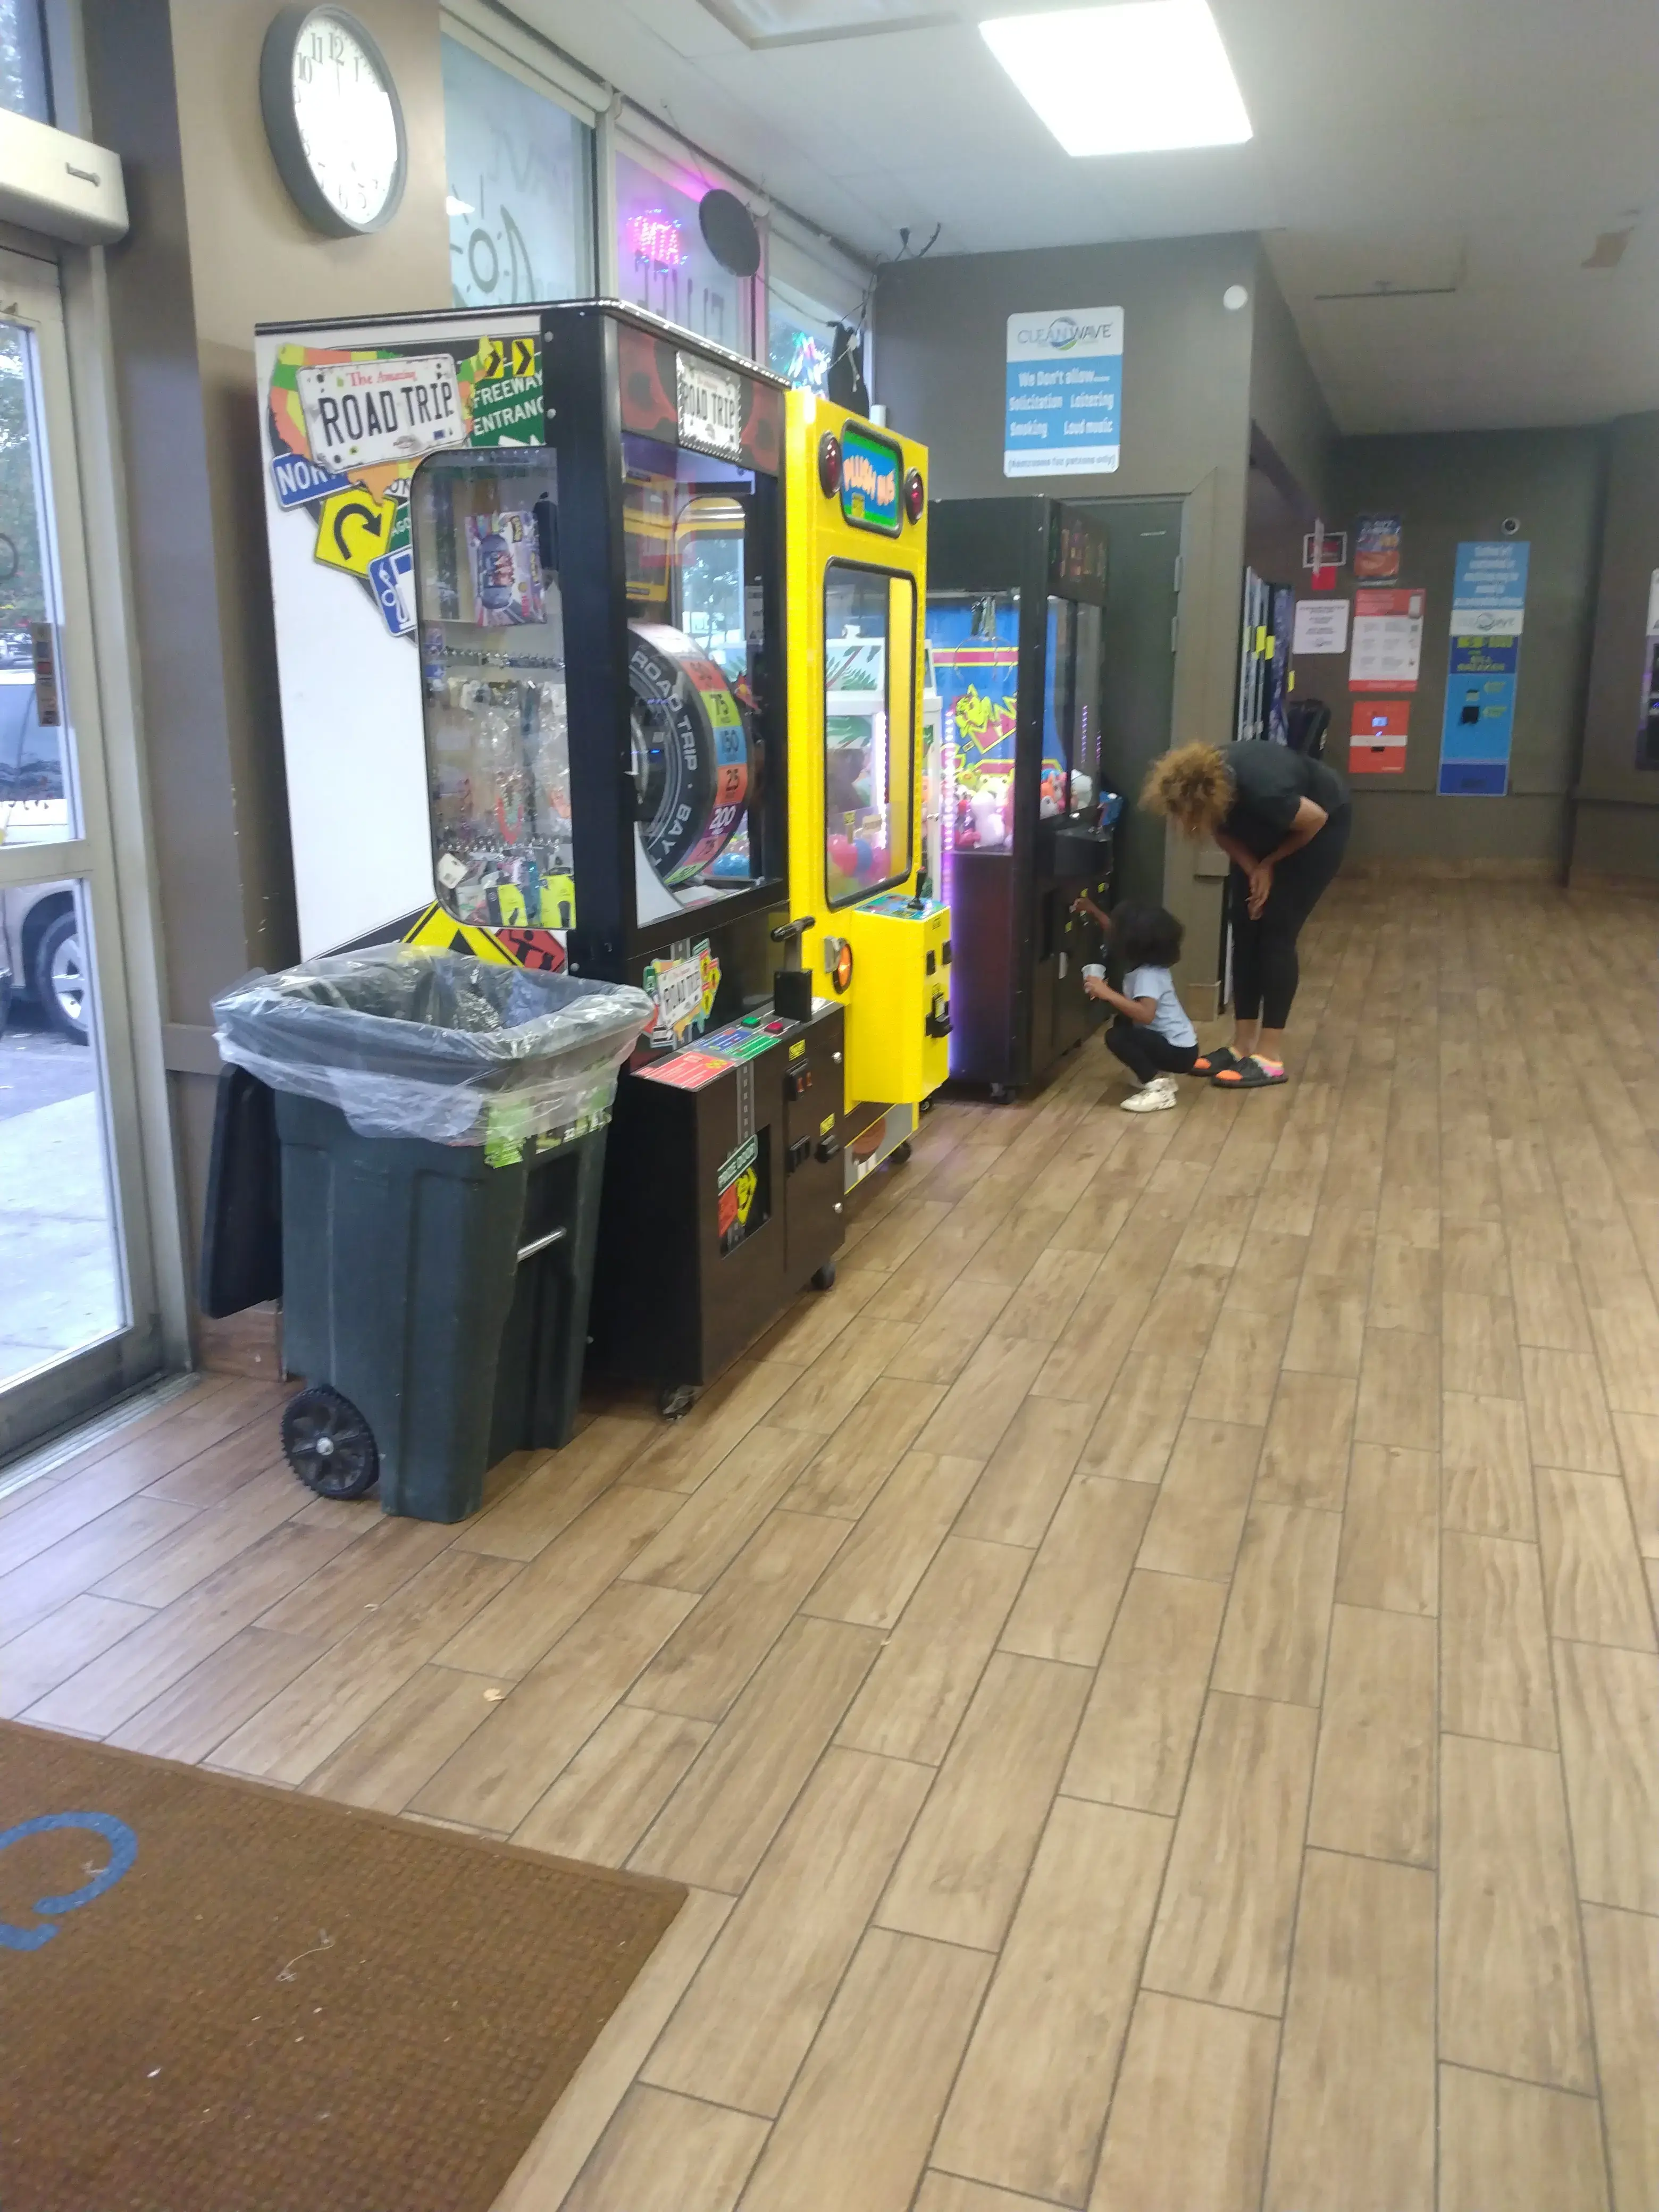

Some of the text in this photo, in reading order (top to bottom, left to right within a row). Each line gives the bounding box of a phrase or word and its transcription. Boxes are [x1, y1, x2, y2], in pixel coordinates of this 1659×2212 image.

[311, 32, 323, 65] 11
[328, 32, 345, 66] 12
[296, 52, 313, 84] 10
[351, 371, 373, 387] The
[473, 368, 543, 409] FREEWAY
[318, 381, 455, 447] ROAD TRIP
[631, 650, 683, 713] ROAD
[677, 714, 698, 770] TRIP
[708, 805, 736, 831] 200
